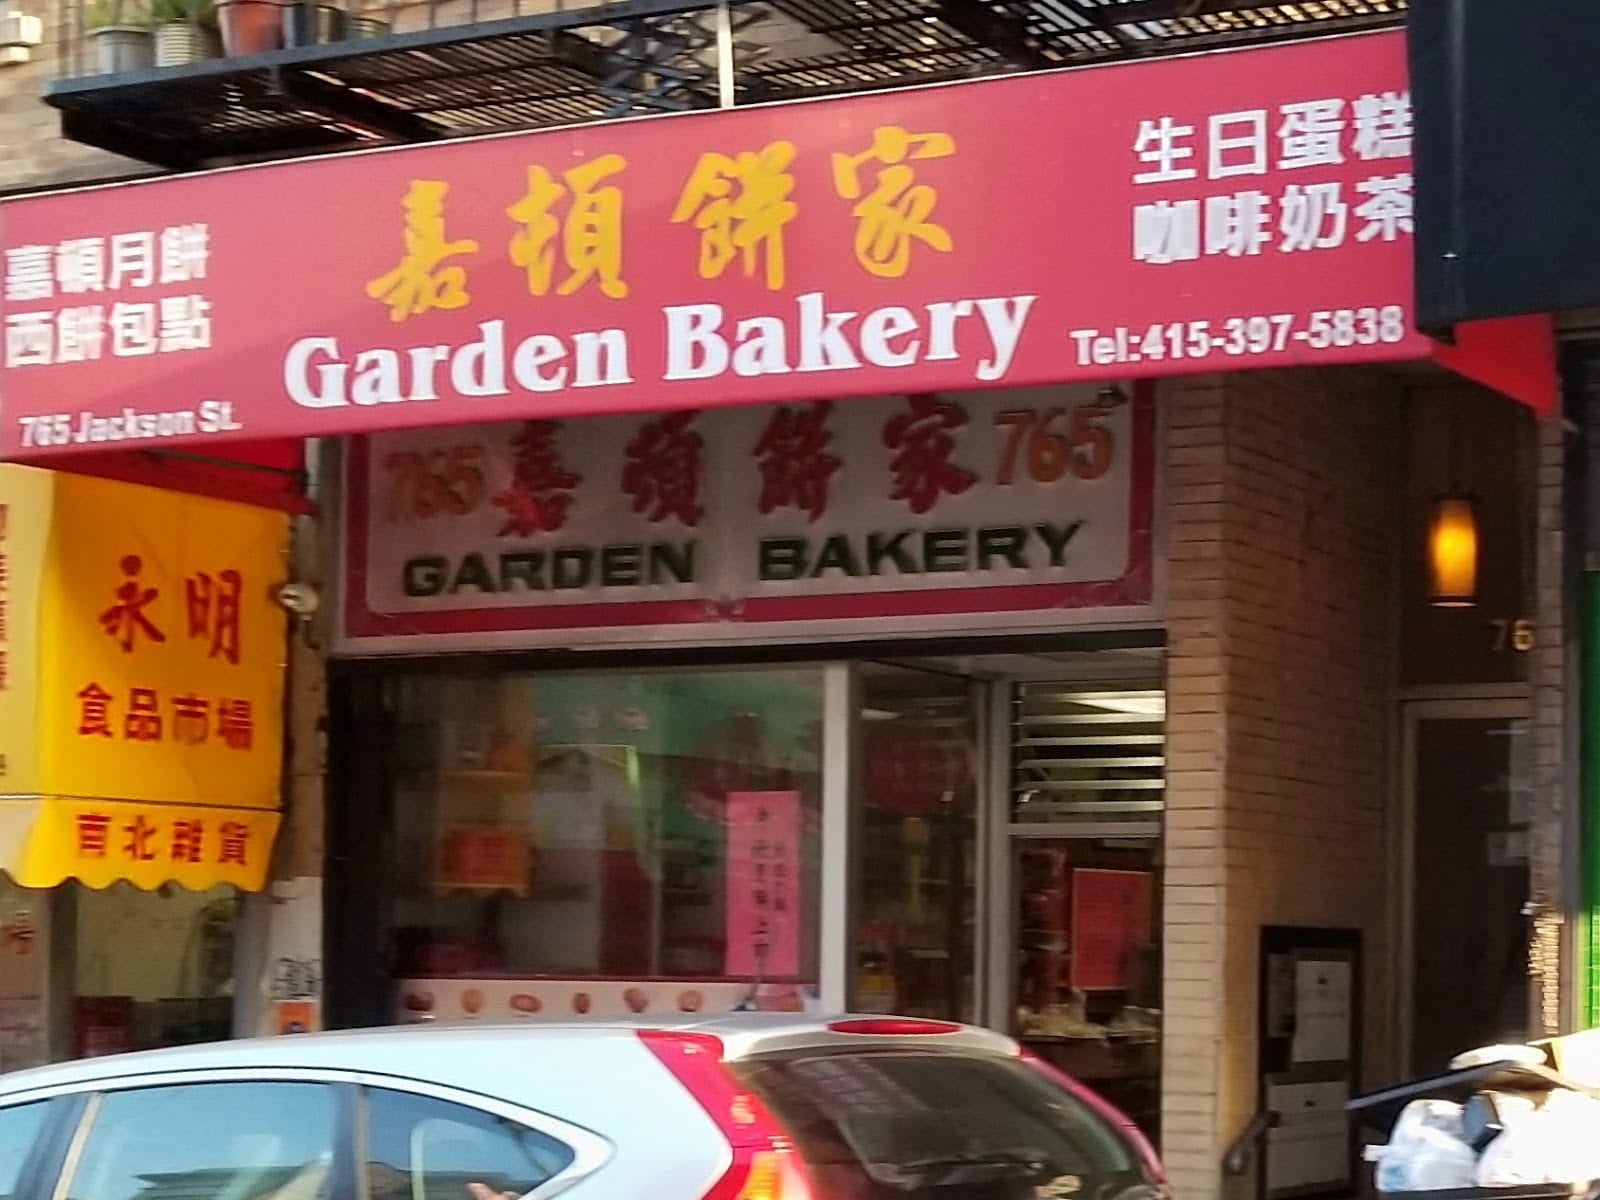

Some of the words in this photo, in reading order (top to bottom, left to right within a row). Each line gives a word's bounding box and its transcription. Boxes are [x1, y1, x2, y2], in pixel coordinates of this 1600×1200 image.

[1132, 91, 1414, 184] 生日蛋糕
[367, 126, 954, 320] 嘉頓餅家
[1132, 173, 1414, 264] 咖啡奶茶
[5, 223, 209, 299] 嘉頓月餅
[5, 295, 211, 367] 西餅包點
[284, 319, 634, 408] Garden
[663, 291, 1037, 381] Bakery
[1071, 306, 1403, 365] Tel:415-397-5838
[18, 414, 72, 447] 765
[72, 408, 196, 443] Jackson
[384, 445, 486, 524] 765
[995, 405, 1114, 486] 765
[403, 538, 698, 596] GARDEN
[757, 519, 1085, 582] BAKERY
[100, 554, 243, 664] 永明
[76, 682, 255, 751] 食品市場
